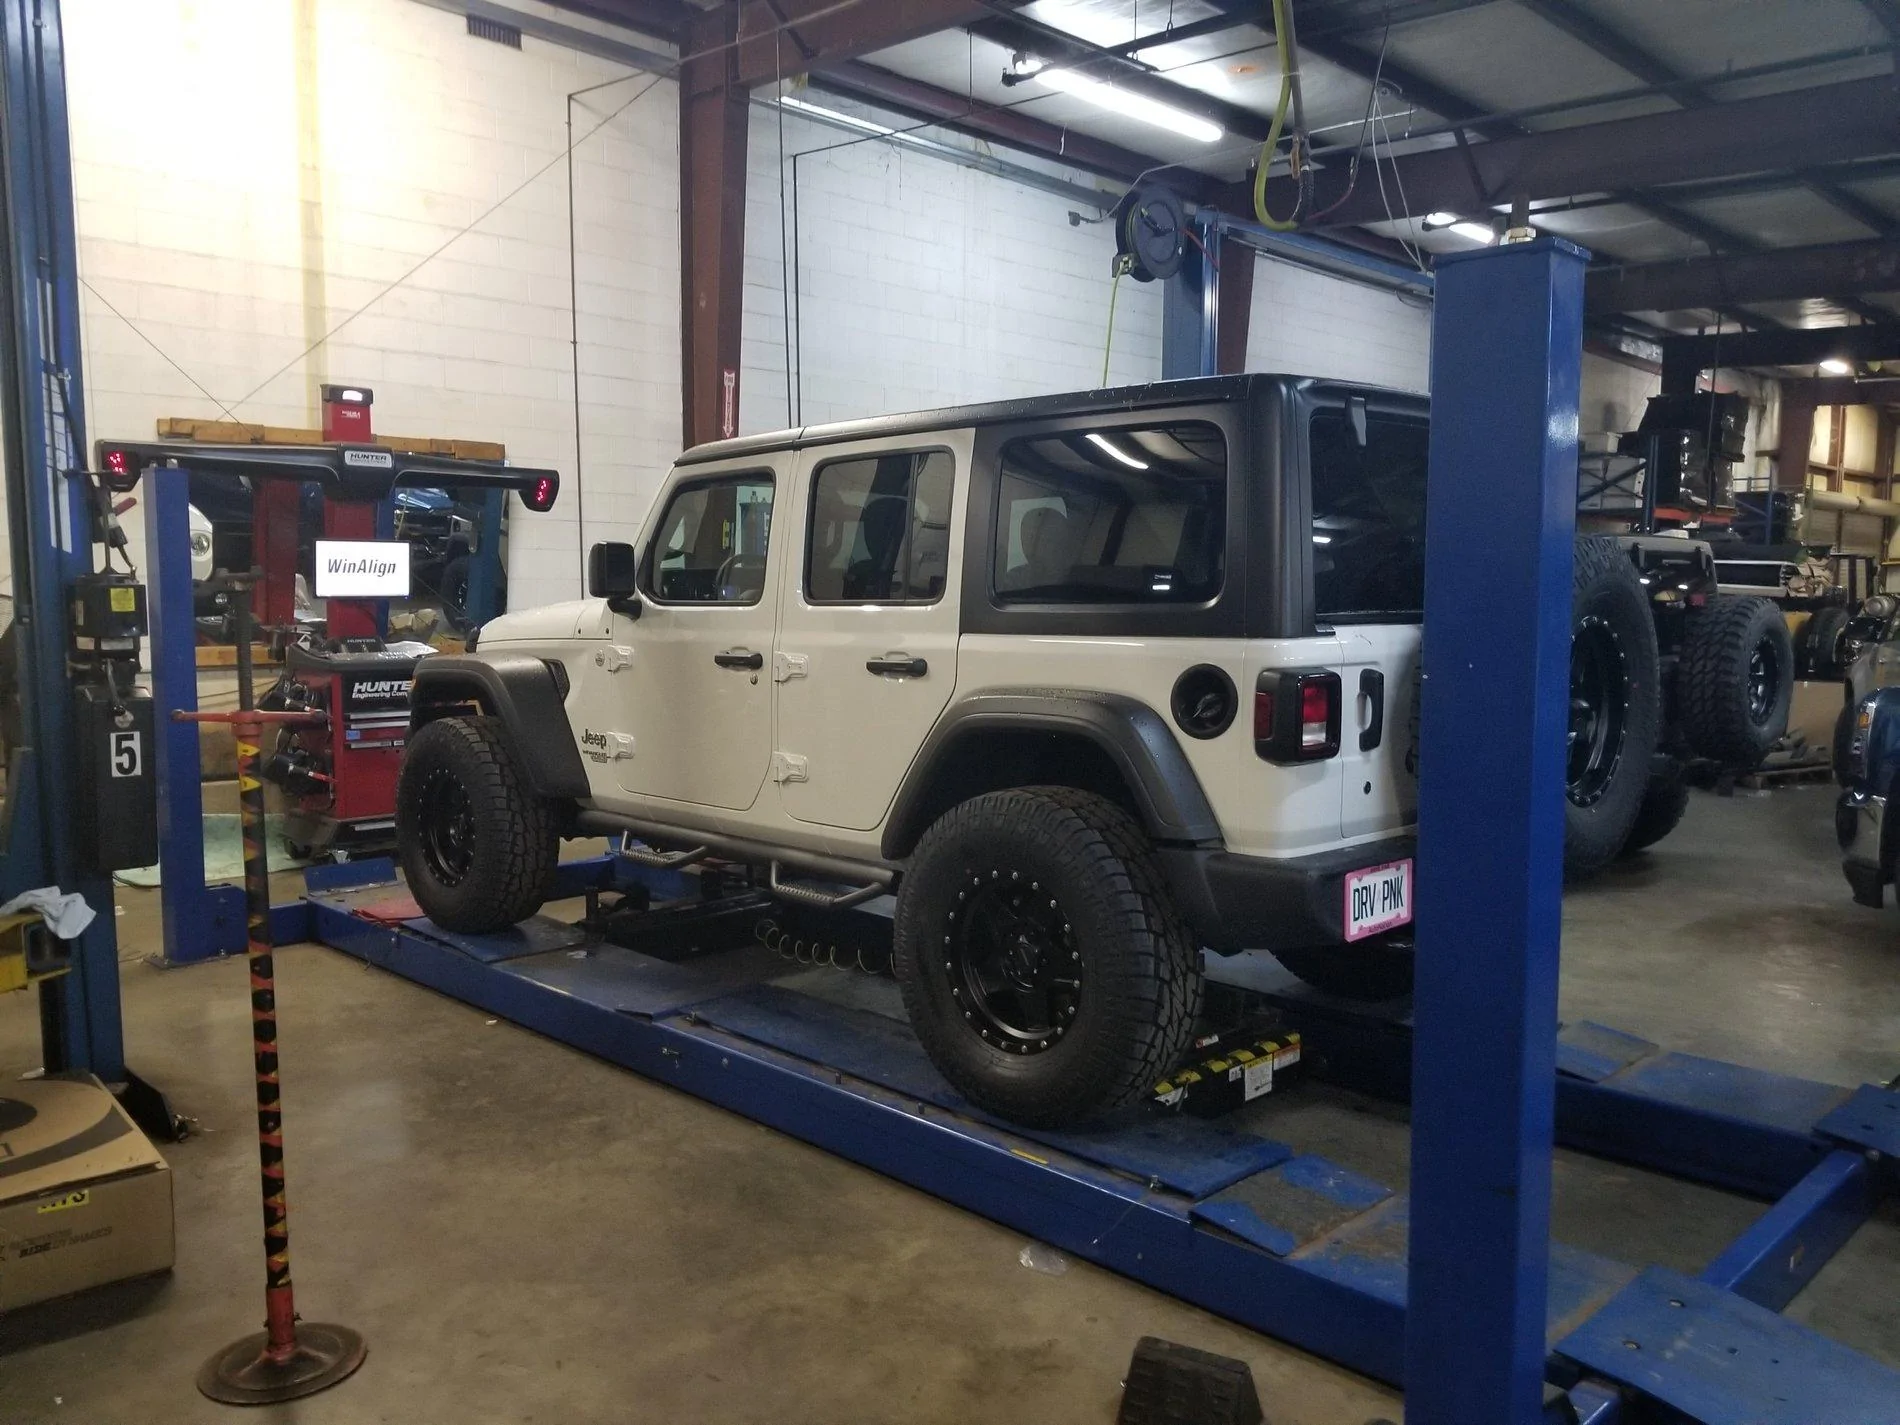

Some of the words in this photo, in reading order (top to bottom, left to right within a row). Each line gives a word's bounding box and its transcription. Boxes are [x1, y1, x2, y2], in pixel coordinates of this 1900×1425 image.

[350, 452, 387, 461] HUNTER
[327, 558, 397, 578] WinAlign
[351, 690, 390, 699] Engineering
[353, 680, 412, 693] HUNTE
[581, 728, 607, 750] Jeep
[115, 733, 137, 775] 5
[1352, 882, 1377, 922] DRV
[1381, 874, 1404, 914] PNK
